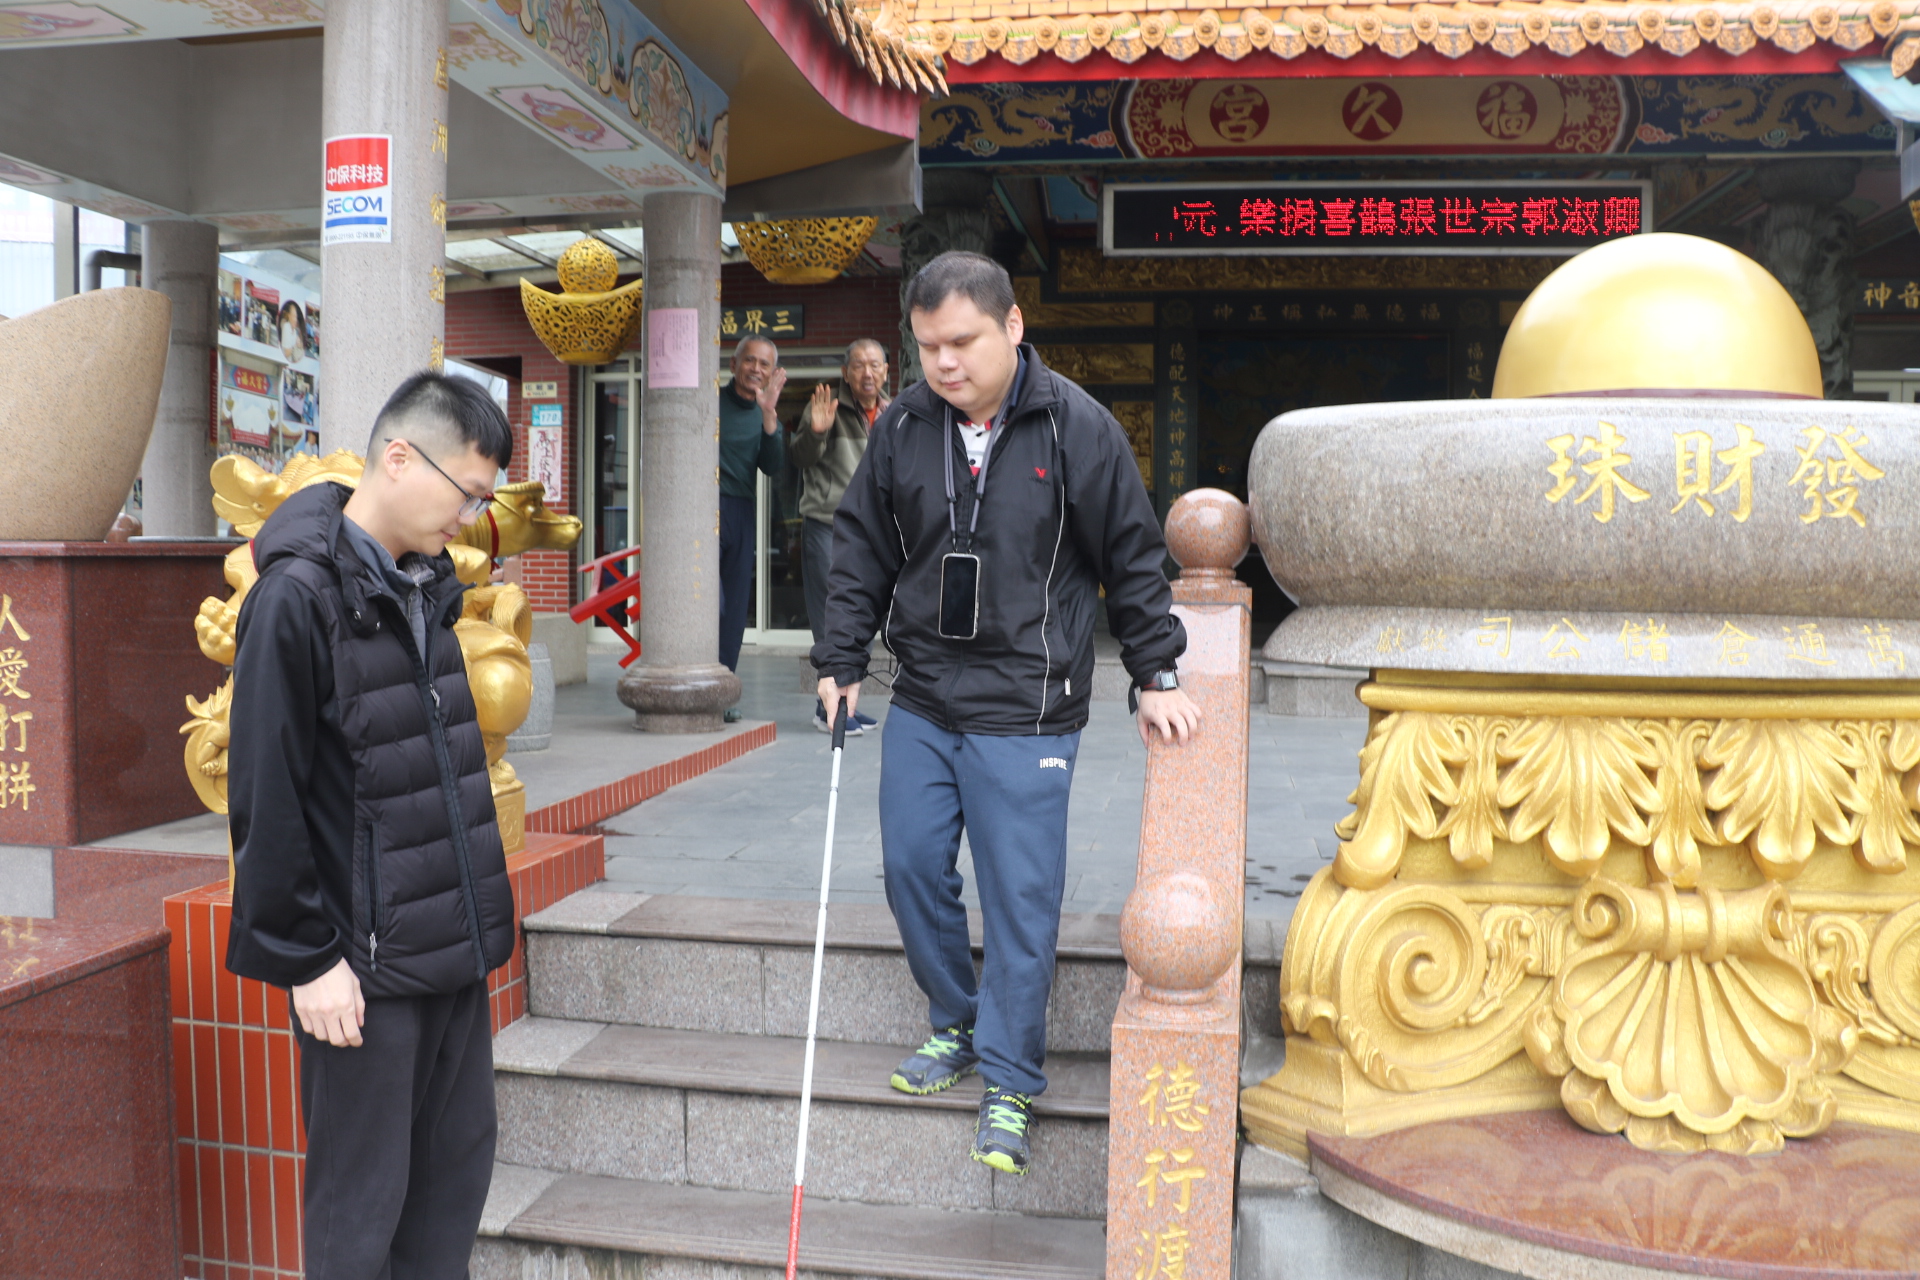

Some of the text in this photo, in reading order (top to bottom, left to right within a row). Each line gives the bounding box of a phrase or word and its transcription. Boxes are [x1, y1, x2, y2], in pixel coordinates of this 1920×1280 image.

[327, 163, 384, 186] 中保科技
[327, 196, 382, 215] SECOM
[1039, 757, 1067, 770] INSPIRE
